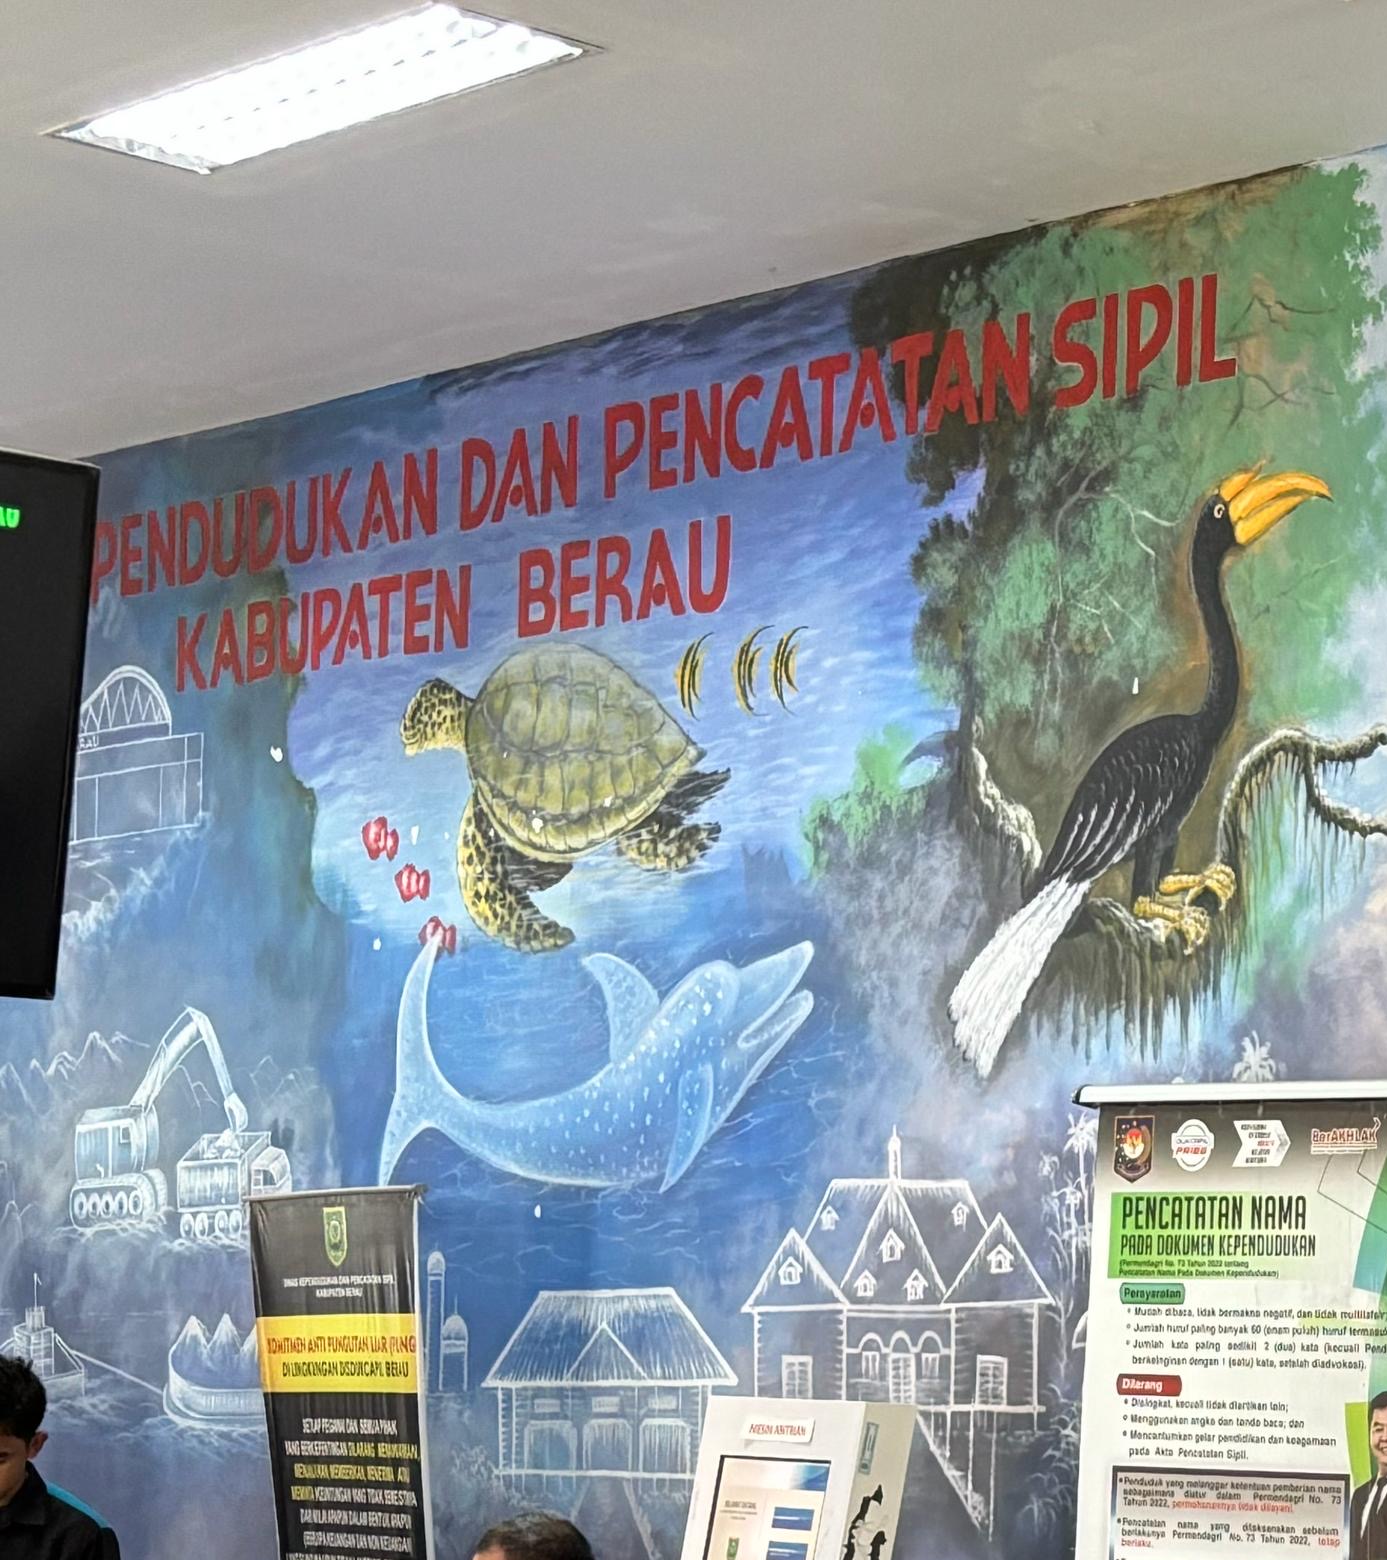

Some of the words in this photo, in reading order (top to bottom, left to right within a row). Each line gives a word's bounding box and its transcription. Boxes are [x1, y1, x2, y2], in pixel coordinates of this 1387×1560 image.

[459, 413, 581, 533] DAN
[603, 312, 1032, 500] PENCATATAN
[1050, 273, 1238, 410] SIPIL
[175, 563, 471, 692] KABUPATEN
[517, 514, 732, 639] BERAU
[1311, 1126, 1377, 1144] BerAKHLAK
[1120, 1196, 1243, 1231] PENCATATAN
[1250, 1195, 1308, 1230] NAMA
[1120, 1234, 1153, 1257] PADA
[1156, 1234, 1215, 1257] DOKUMEN
[1219, 1234, 1317, 1257] KEPENDUDUKAN
[1123, 1286, 1182, 1302] Persyaratan
[1122, 1378, 1163, 1393] Dilarang
